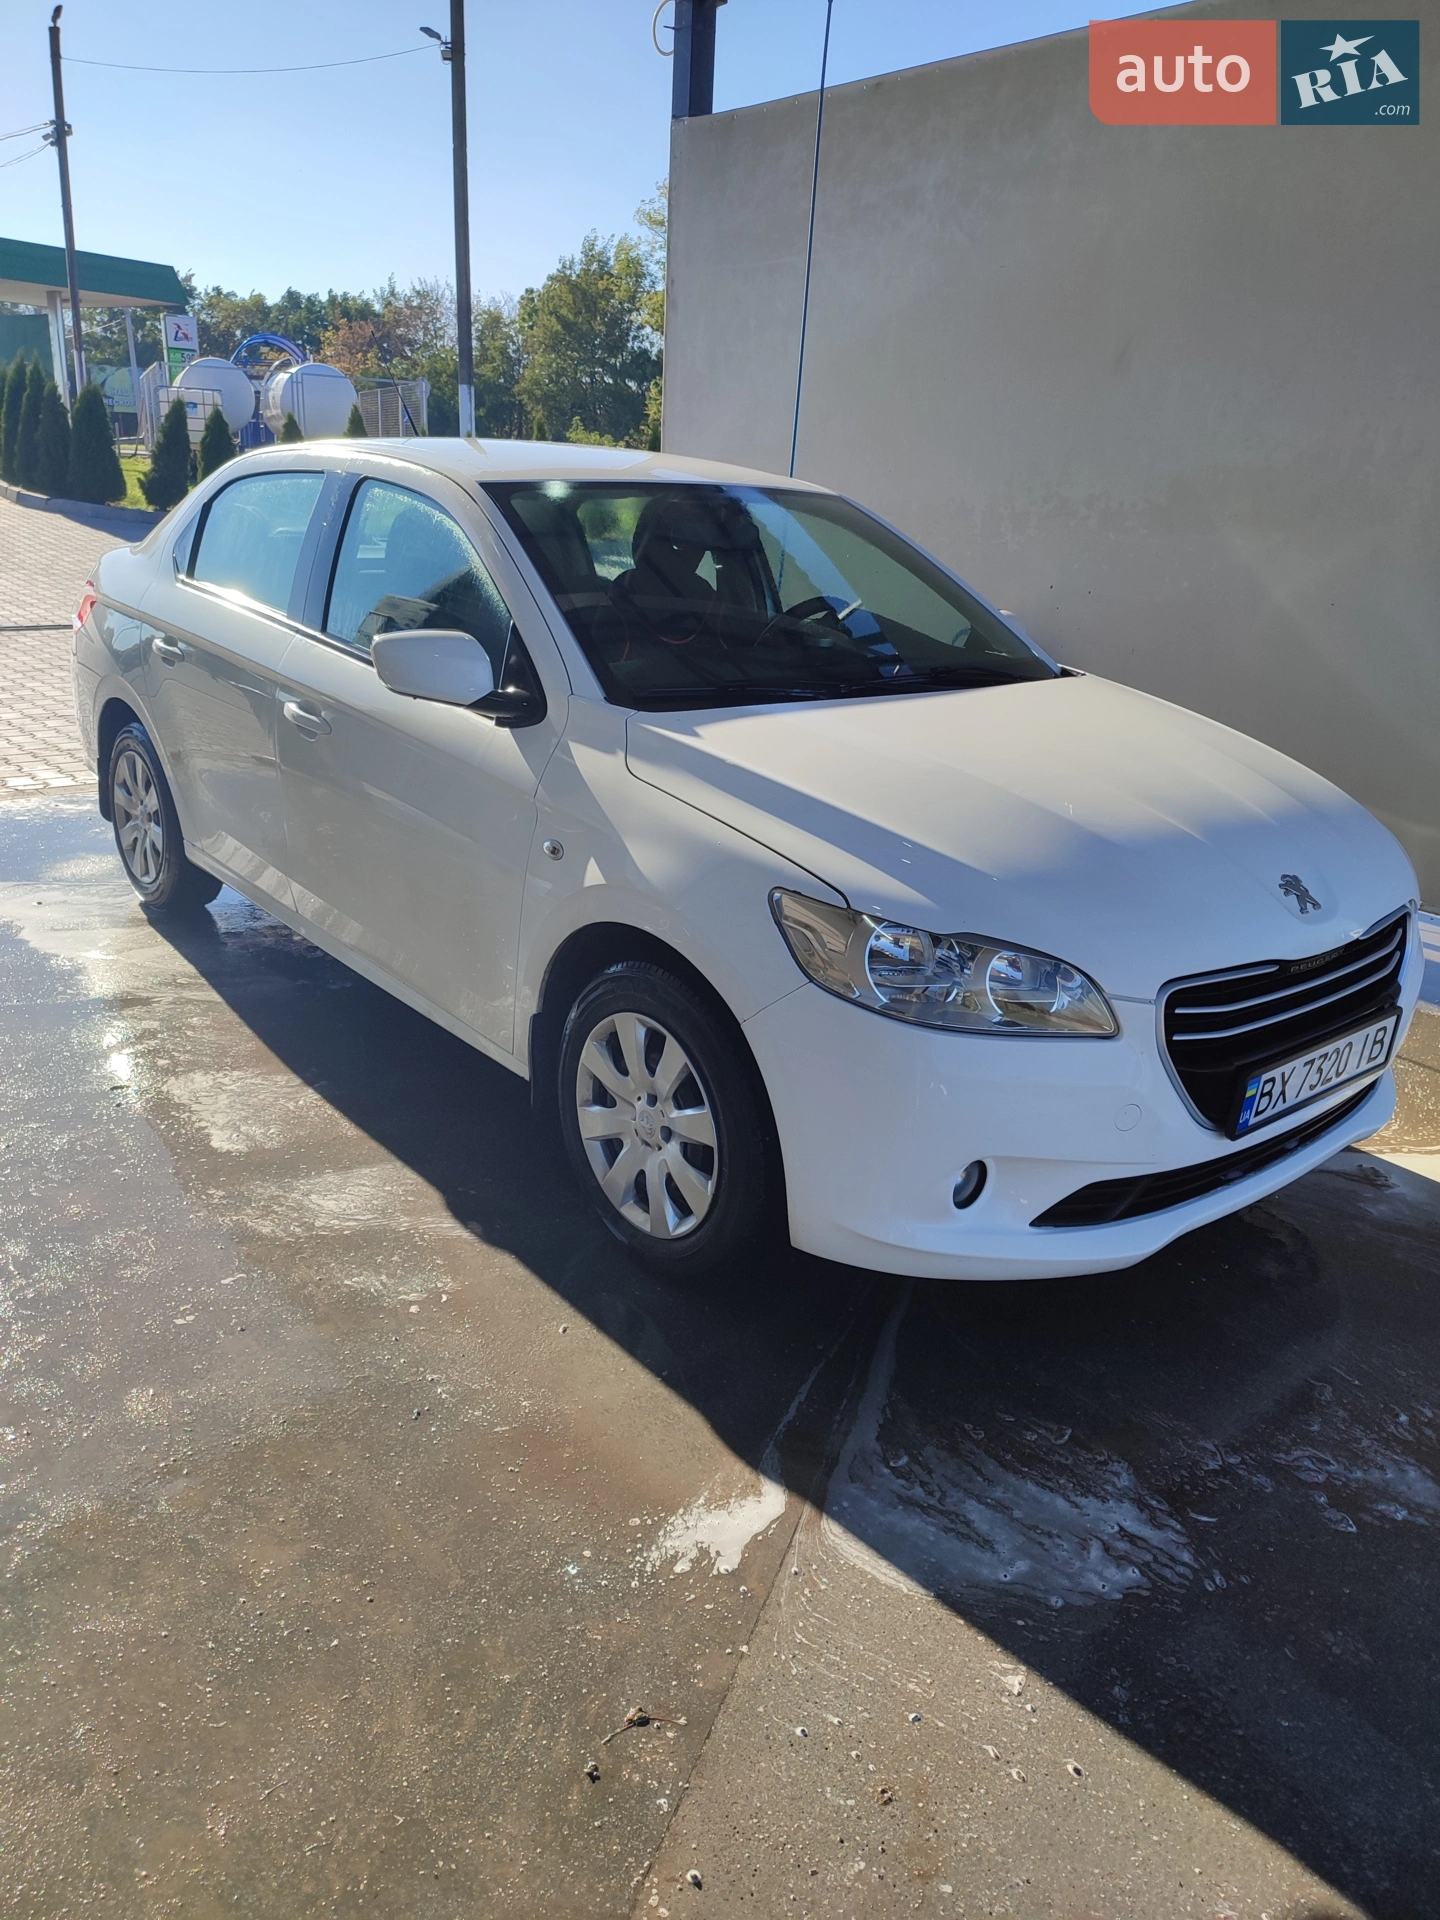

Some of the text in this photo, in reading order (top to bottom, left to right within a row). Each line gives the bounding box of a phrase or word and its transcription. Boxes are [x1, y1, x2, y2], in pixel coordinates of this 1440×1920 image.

[1290, 948, 1345, 973] PEUGEOT
[1253, 1025, 1388, 1118] BX 7320 IB
